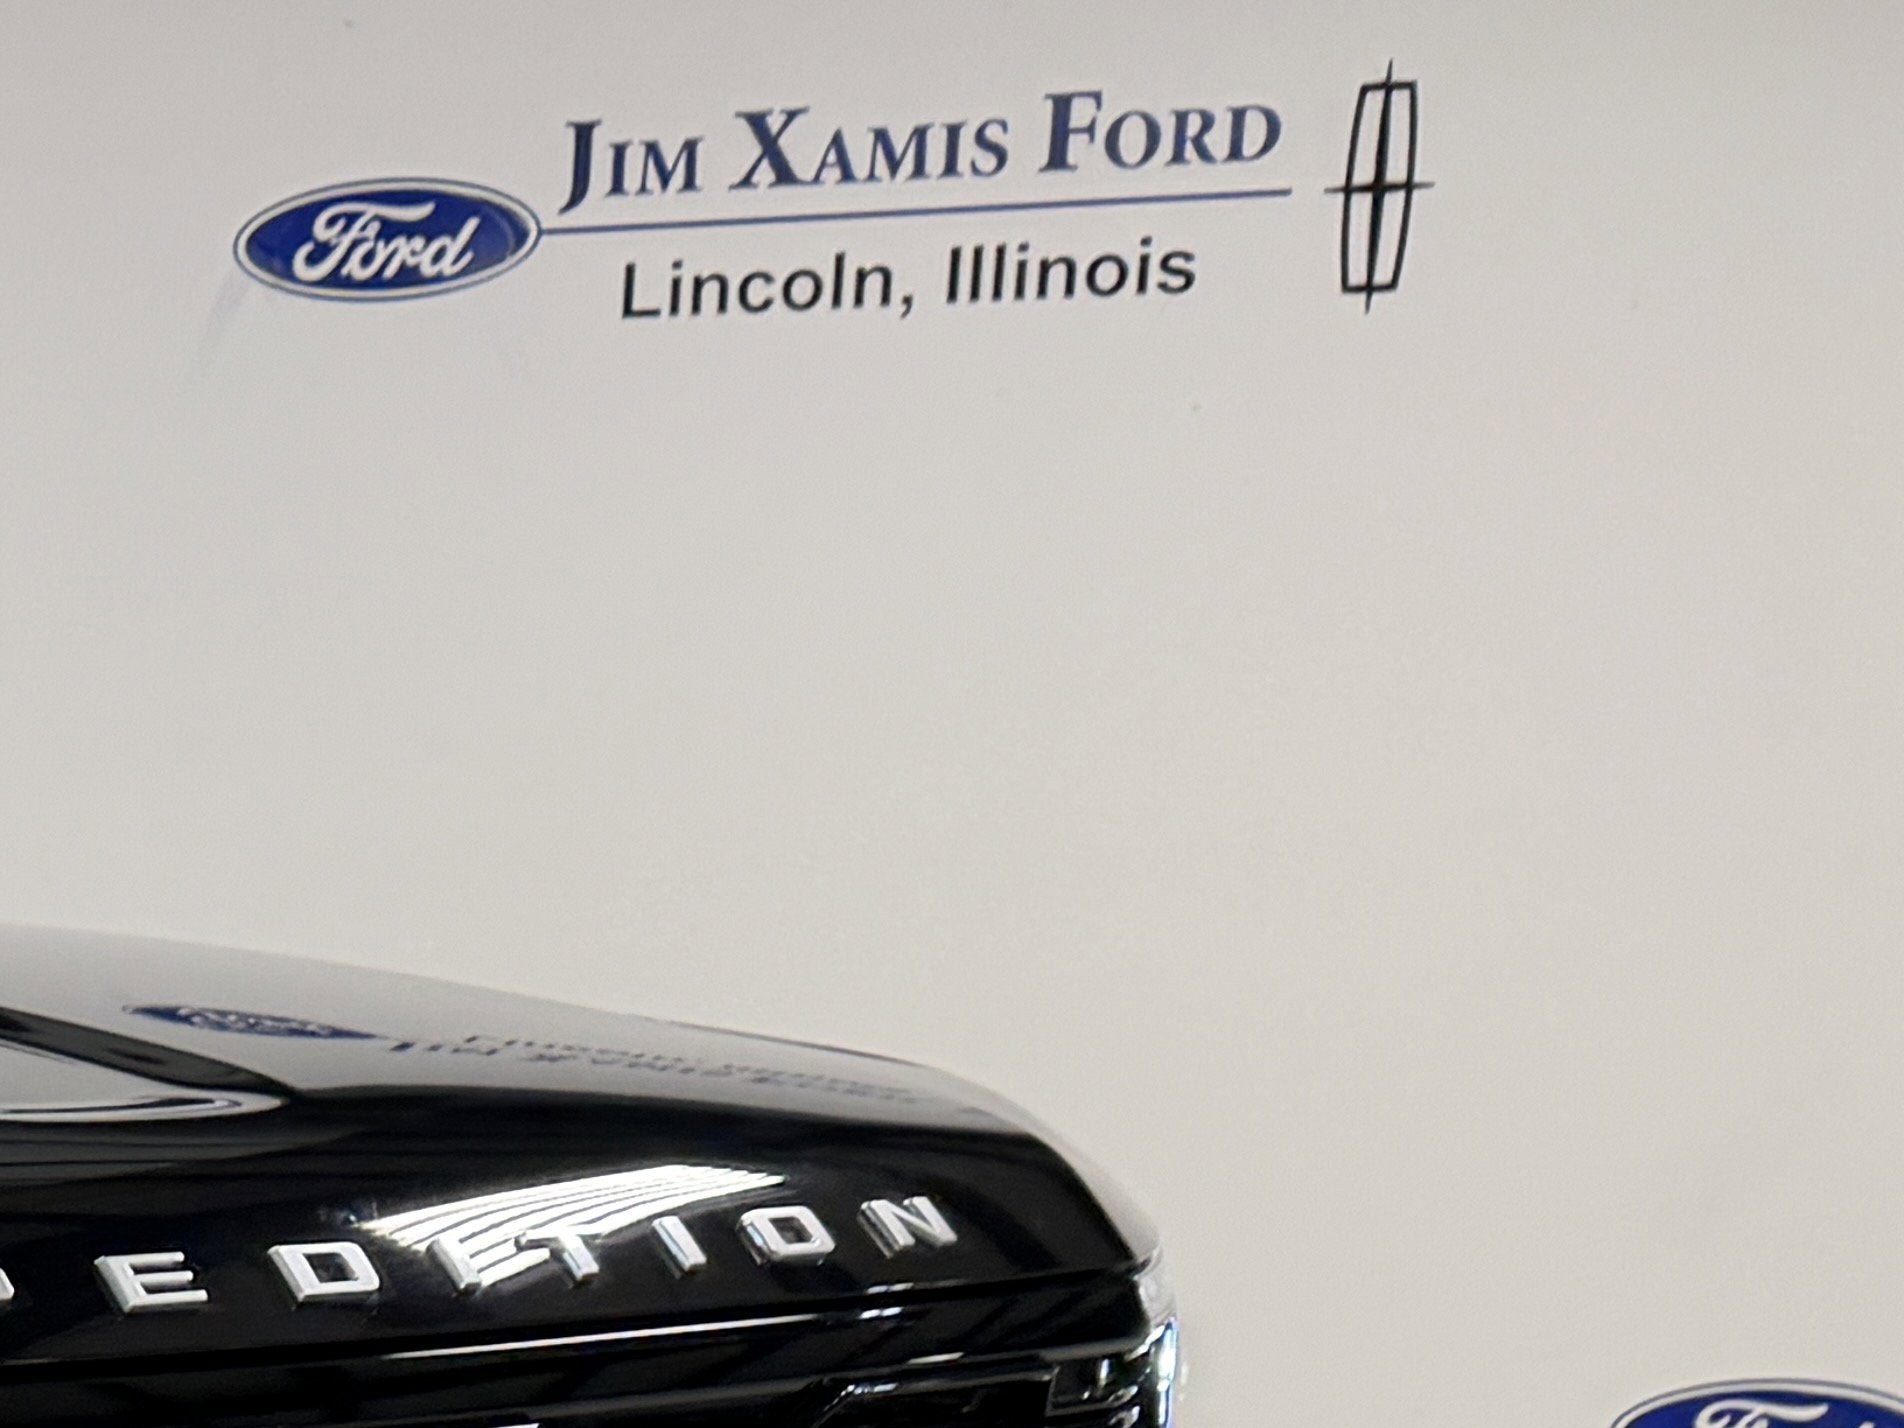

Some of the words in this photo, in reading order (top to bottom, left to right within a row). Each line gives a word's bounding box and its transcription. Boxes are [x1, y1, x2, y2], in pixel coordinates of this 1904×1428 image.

[558, 118, 704, 216] JIM
[728, 106, 1010, 190] XAMIS
[1038, 90, 1283, 174] FORD
[293, 200, 481, 282] Ford
[621, 251, 914, 320] Lincoln,
[945, 236, 1197, 304] Illinois
